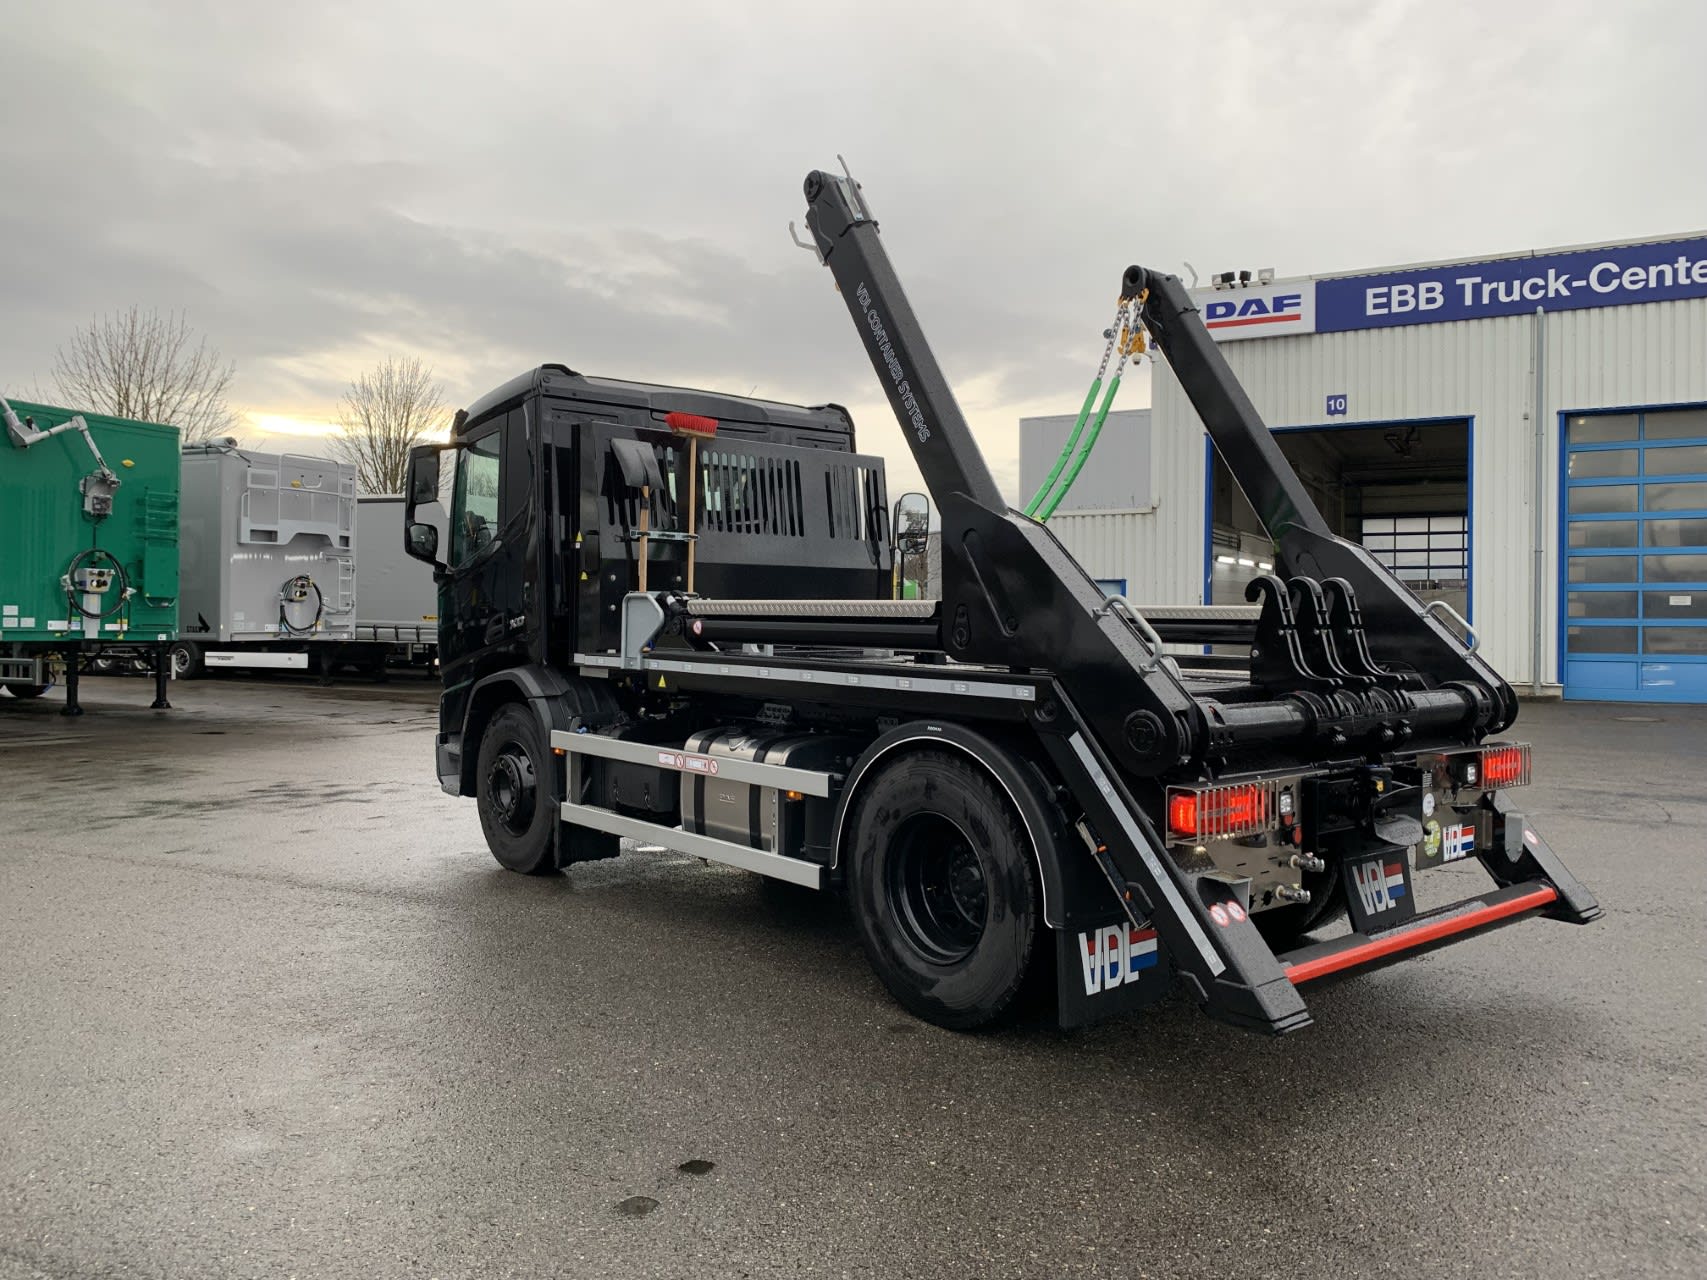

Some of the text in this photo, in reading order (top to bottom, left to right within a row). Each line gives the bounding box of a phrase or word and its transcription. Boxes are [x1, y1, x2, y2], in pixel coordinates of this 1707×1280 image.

[1206, 294, 1302, 320] DAF
[1365, 281, 1443, 317] EBB
[856, 281, 931, 443] VDL CONTAINER SYSTEMS
[1327, 398, 1345, 411] 10
[1443, 823, 1467, 862] VDL
[1352, 859, 1397, 916] VDL
[1078, 921, 1140, 996] VDL
